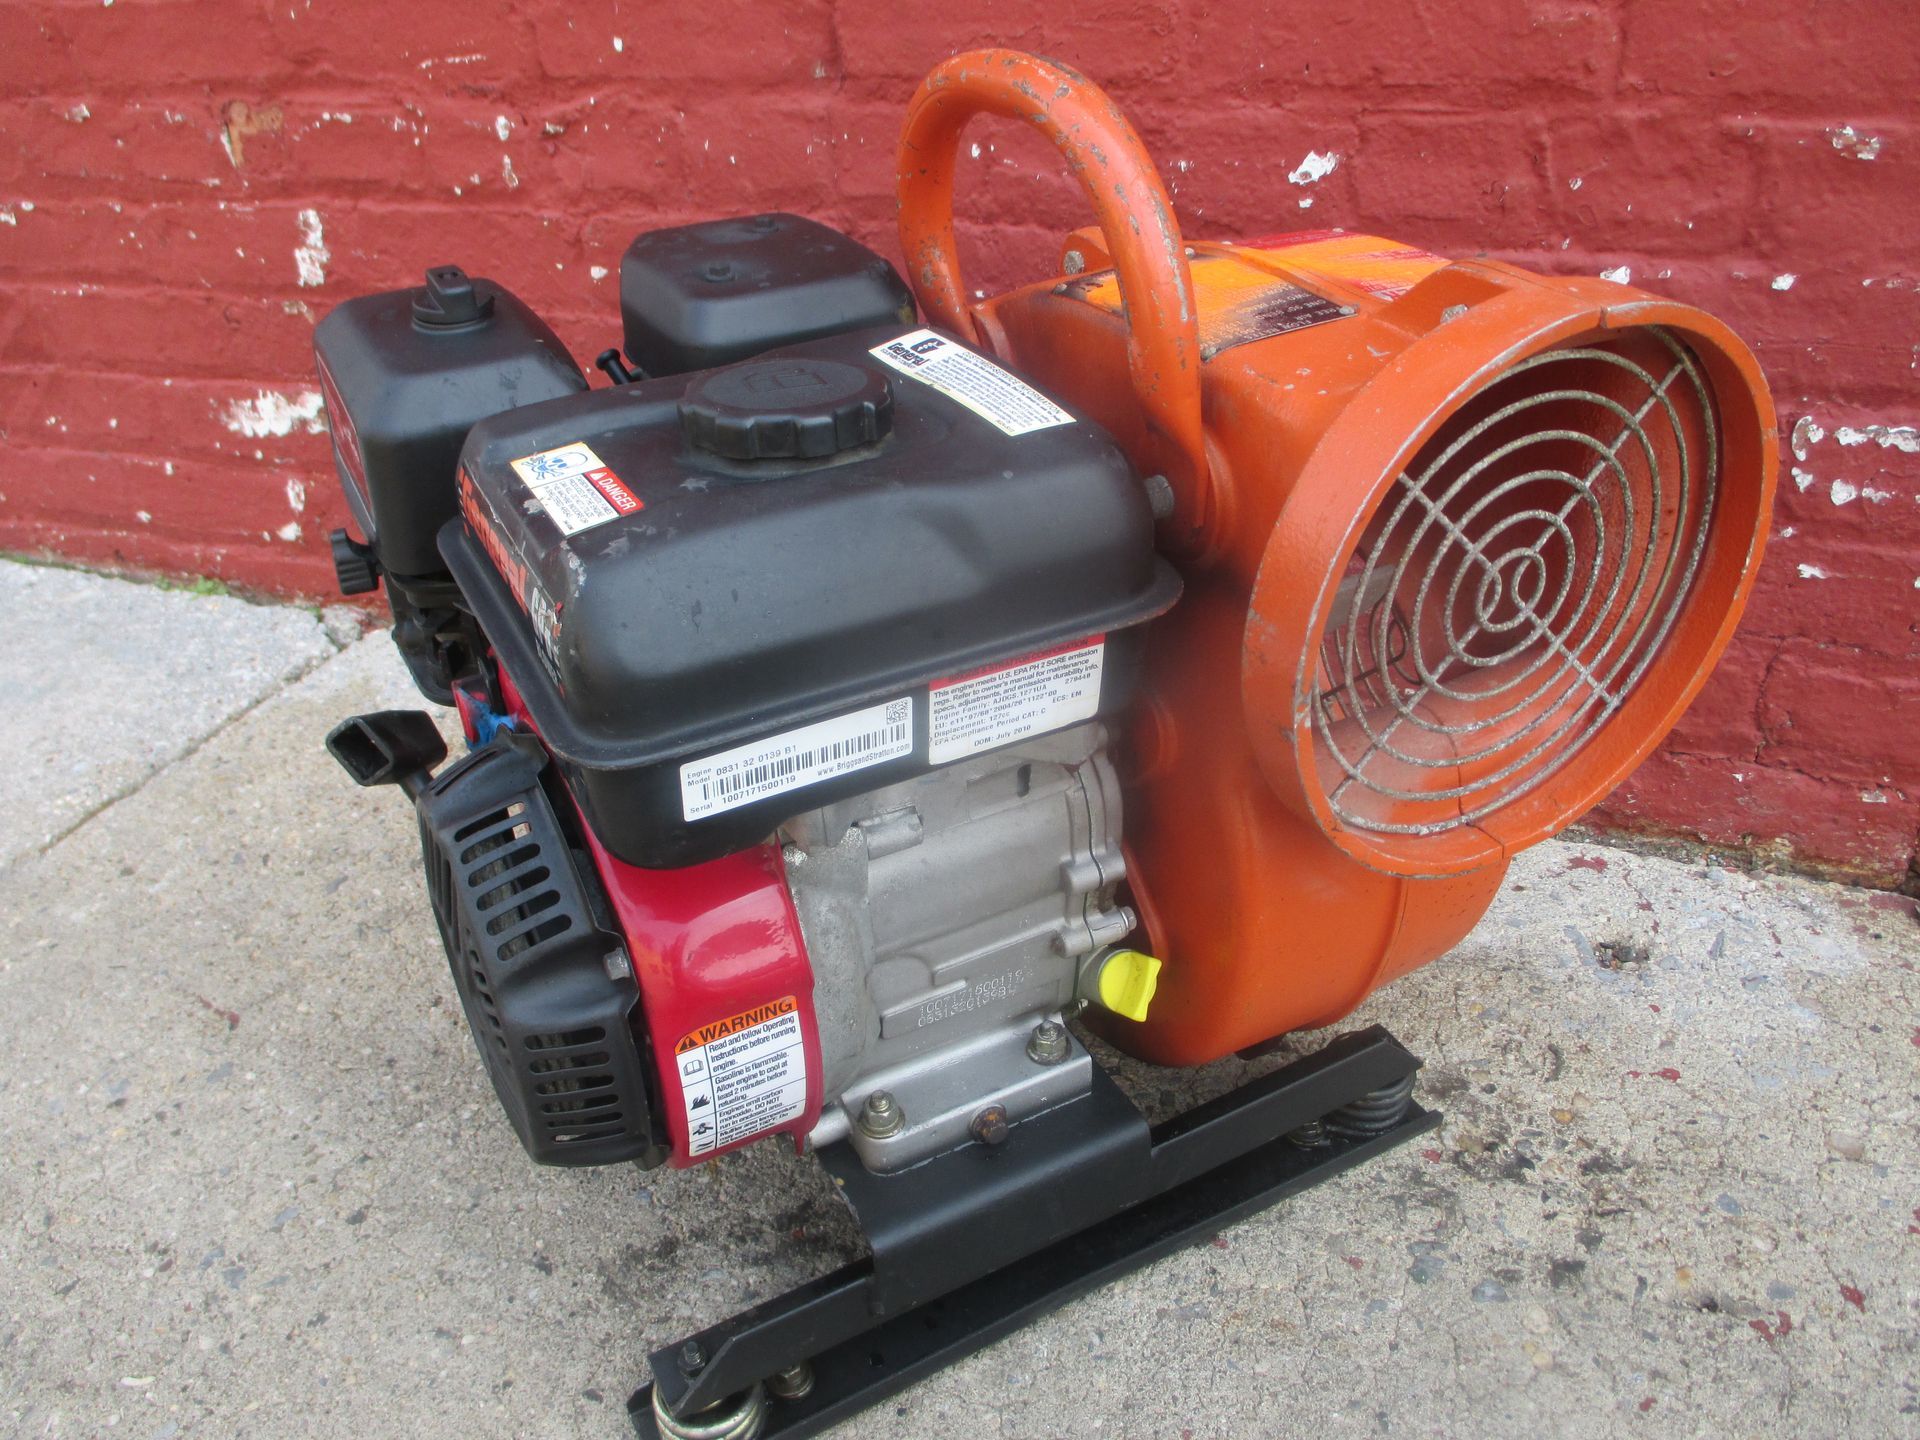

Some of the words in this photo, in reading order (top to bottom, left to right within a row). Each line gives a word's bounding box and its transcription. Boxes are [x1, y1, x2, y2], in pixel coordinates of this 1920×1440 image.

[888, 342, 930, 366] General
[599, 479, 637, 510] DANGER
[933, 696, 950, 707] regs.
[953, 690, 971, 700] Refer
[981, 679, 1008, 692] owner's
[1009, 672, 1035, 684] manual
[1036, 669, 1045, 677] for
[1046, 657, 1089, 674] maintenance
[934, 688, 949, 698] This
[950, 682, 974, 695] engine
[975, 675, 997, 687] meets
[998, 670, 1012, 680] U.S.
[1013, 666, 1028, 676] EPA
[1029, 663, 1039, 671] PH
[1046, 655, 1066, 666] SORE
[1067, 647, 1098, 661] emission
[933, 703, 956, 715] specs,
[958, 690, 999, 707] adjustments,
[1002, 685, 1016, 694] and
[1017, 675, 1051, 690] emissions
[1053, 666, 1083, 681] durability
[1084, 662, 1098, 671] info.
[1052, 693, 1068, 703] ECS:
[1070, 689, 1081, 698] EM
[934, 709, 959, 722] Engine
[962, 700, 990, 714] Family:
[934, 720, 947, 730] EU:
[934, 717, 985, 739] Displacement:
[989, 711, 1009, 722] 127cc
[951, 722, 993, 741] Compliance
[996, 715, 1019, 727] Period
[1022, 709, 1037, 719] CAT:
[995, 730, 1010, 740] July
[687, 766, 711, 781] Engine
[716, 762, 739, 776] 0831
[742, 757, 754, 768] 32
[758, 749, 781, 763] 0139
[784, 744, 796, 754] B1
[817, 741, 909, 778] www.BriggsandStratton.com
[687, 773, 710, 787] Model
[690, 801, 712, 814] Serial
[722, 774, 795, 804] 1007171500119
[699, 1001, 793, 1043] WARNING
[708, 1039, 726, 1053] Read
[727, 1033, 740, 1046] and
[741, 1025, 761, 1040] follow
[762, 1012, 794, 1034] Operating
[710, 1041, 748, 1063] Instructions
[749, 1033, 769, 1048] before
[770, 1023, 795, 1042] running
[712, 1057, 737, 1073] engine.
[714, 1066, 744, 1085] Gasoline
[744, 1064, 751, 1073] is
[751, 1049, 788, 1070] flammable.
[716, 1079, 734, 1093] Allow
[735, 1071, 758, 1086] engine
[759, 1068, 765, 1076] to
[766, 1062, 779, 1073] cool
[780, 1059, 788, 1068] at
[717, 1089, 733, 1101] least
[739, 1076, 765, 1092] minutes
[766, 1068, 787, 1082] before
[718, 1102, 744, 1118] Engines
[761, 1087, 783, 1101] carbon
[719, 1120, 730, 1130] run
[731, 1117, 737, 1125] in
[738, 1105, 767, 1122] enclosed
[754, 1101, 764, 1110] DO
[766, 1095, 780, 1106] NOT
